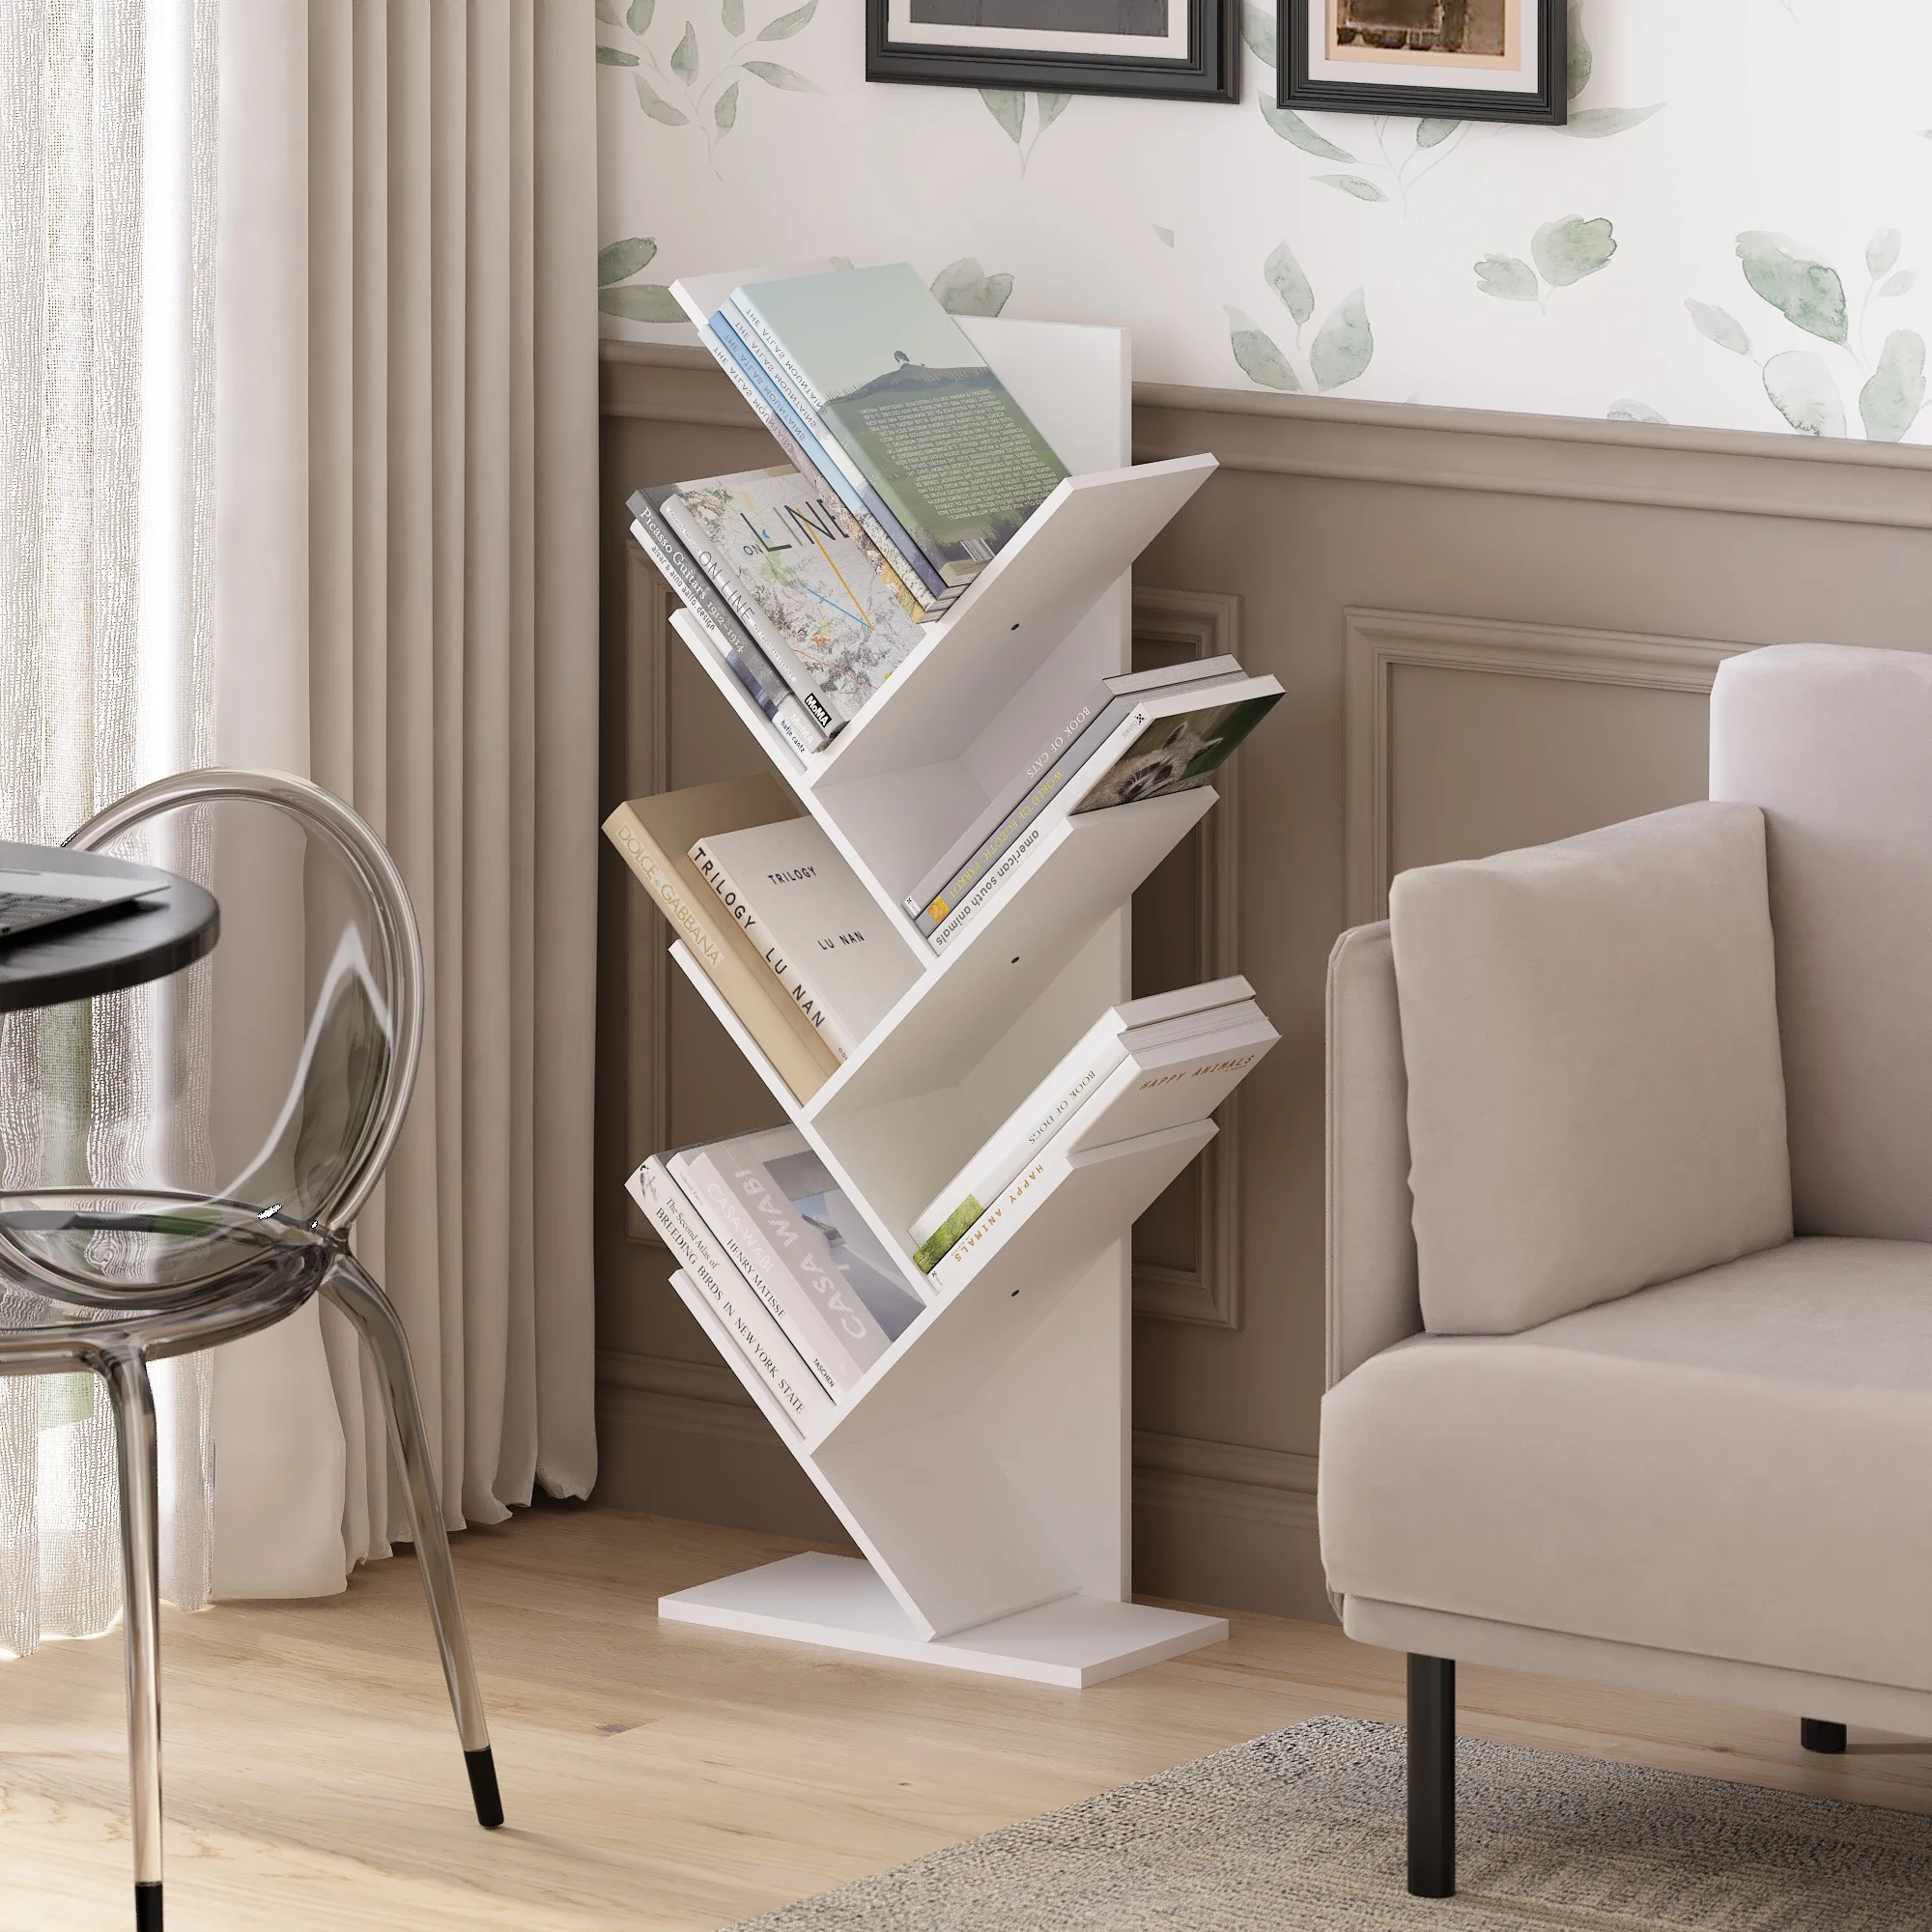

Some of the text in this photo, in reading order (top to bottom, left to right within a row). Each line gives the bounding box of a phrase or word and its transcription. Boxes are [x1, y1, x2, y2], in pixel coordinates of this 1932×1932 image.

[639, 506, 673, 554] Picasso
[672, 552, 707, 600] Guitars
[742, 543, 764, 556] ON
[651, 546, 667, 565] alvar
[669, 569, 683, 588] aino
[696, 607, 716, 632] design
[698, 551, 755, 625] ON LINE
[780, 719, 806, 753] hatje cantz
[789, 713, 813, 745] MoMA
[805, 695, 830, 726] MoMA
[1026, 706, 1091, 779] BOOK OF CATS
[1018, 805, 1032, 822] OF
[1031, 770, 1064, 806] WORLD
[617, 825, 658, 879] DOLCE
[660, 884, 720, 966] GABBANA
[767, 866, 817, 886] TRILOGY
[936, 830, 1039, 946] american south animals
[948, 861, 982, 900] PARROT
[694, 847, 825, 1028] TRILOGY LU NAN
[817, 931, 865, 951] LU NAN
[1028, 1070, 1095, 1145] BOOK OF DOGS
[1139, 1054, 1255, 1091] HAPPY ANIMALS
[666, 1196, 721, 1268] The Second Atlas of
[707, 1182, 775, 1273] CASA WABI
[954, 1164, 1044, 1262] HAPPY ANIMALS
[726, 1237, 786, 1320] HENRY MATISSE
[733, 1168, 867, 1339] CASA WABI
[656, 1208, 806, 1414] BREEDING BIRDS IN NEW YORK STATE
[812, 1357, 836, 1387] TASCHEN
